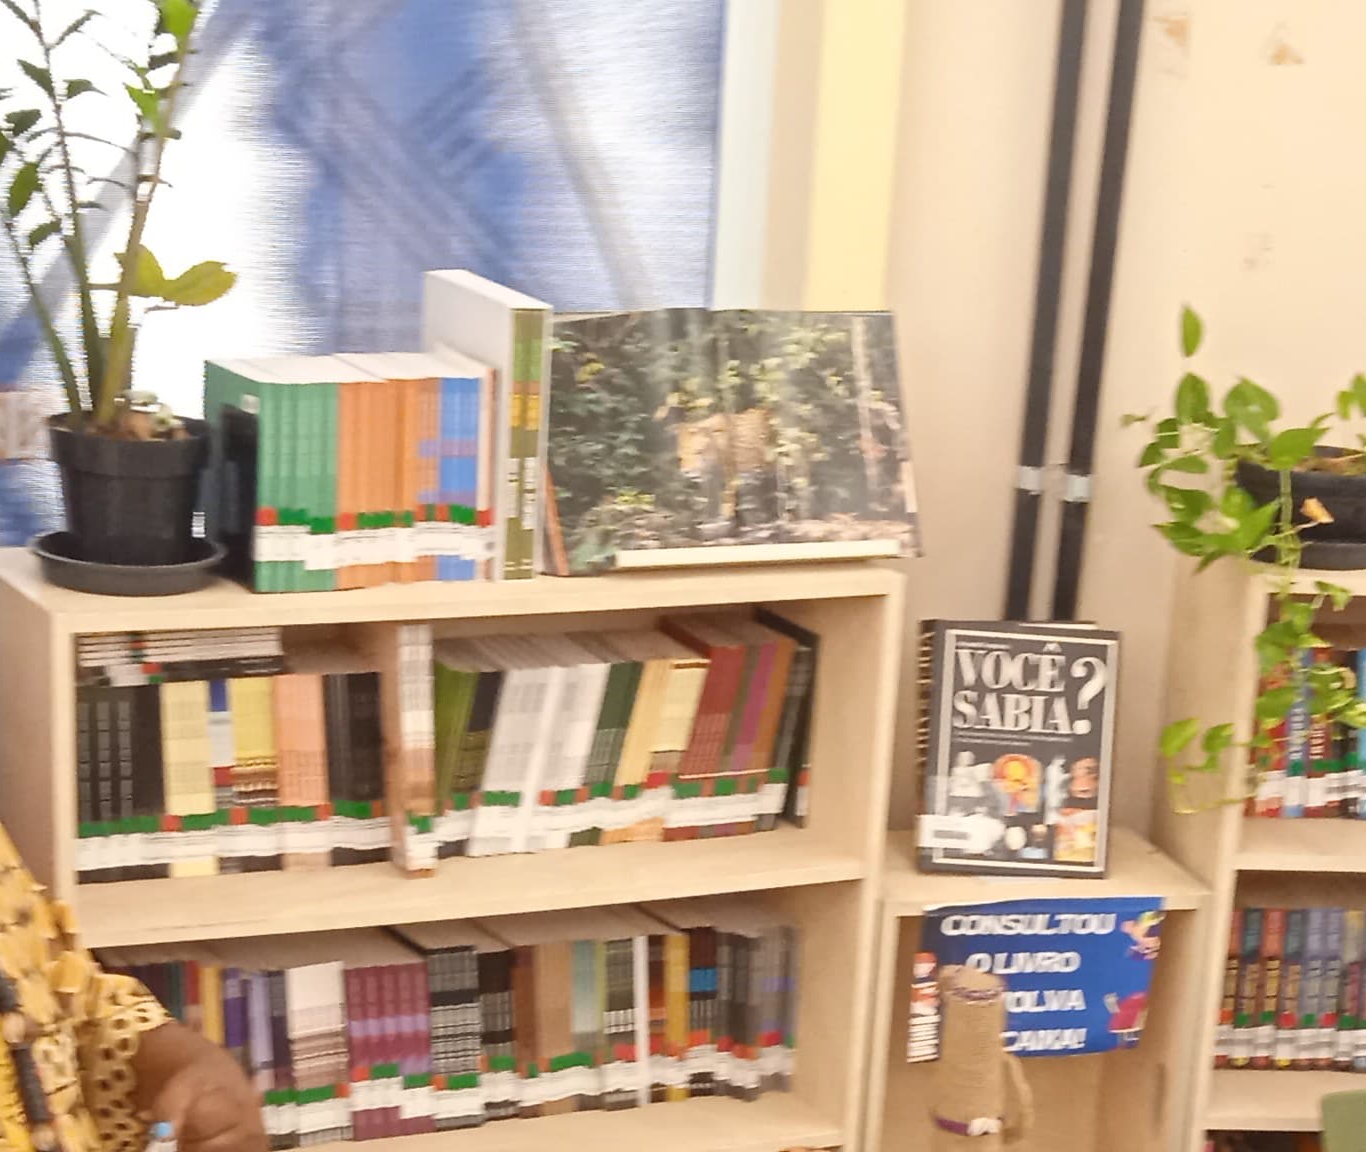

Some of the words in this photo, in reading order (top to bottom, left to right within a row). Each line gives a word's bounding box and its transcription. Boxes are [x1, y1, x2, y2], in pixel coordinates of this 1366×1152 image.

[953, 642, 1068, 692] VOCÊ
[940, 913, 1117, 936] CONSULTOU
[965, 952, 992, 974] O
[992, 952, 1082, 975] LIVRO
[1003, 989, 1086, 1014] OLVA
